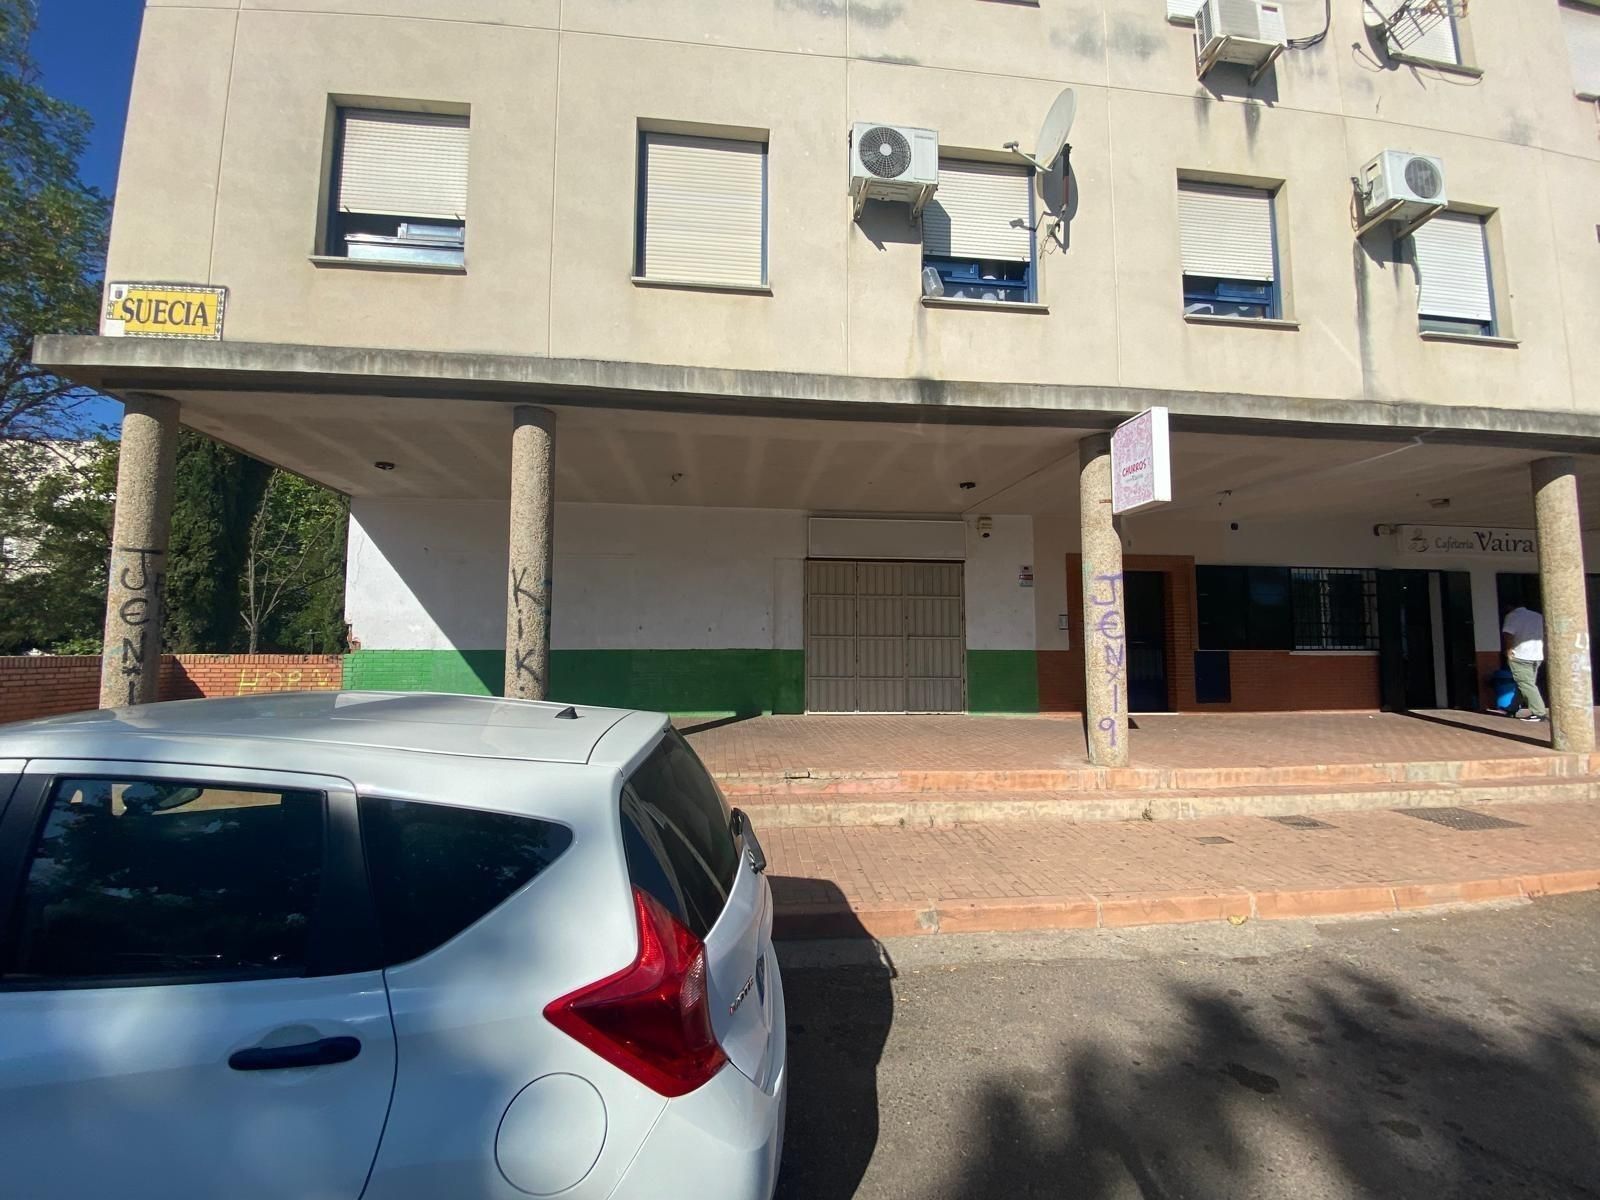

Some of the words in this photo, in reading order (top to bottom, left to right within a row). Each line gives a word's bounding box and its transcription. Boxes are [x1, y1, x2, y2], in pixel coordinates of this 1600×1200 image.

[121, 297, 209, 327] SUECIA
[1122, 459, 1146, 478] CHURROS
[1473, 531, 1535, 553] Vaira
